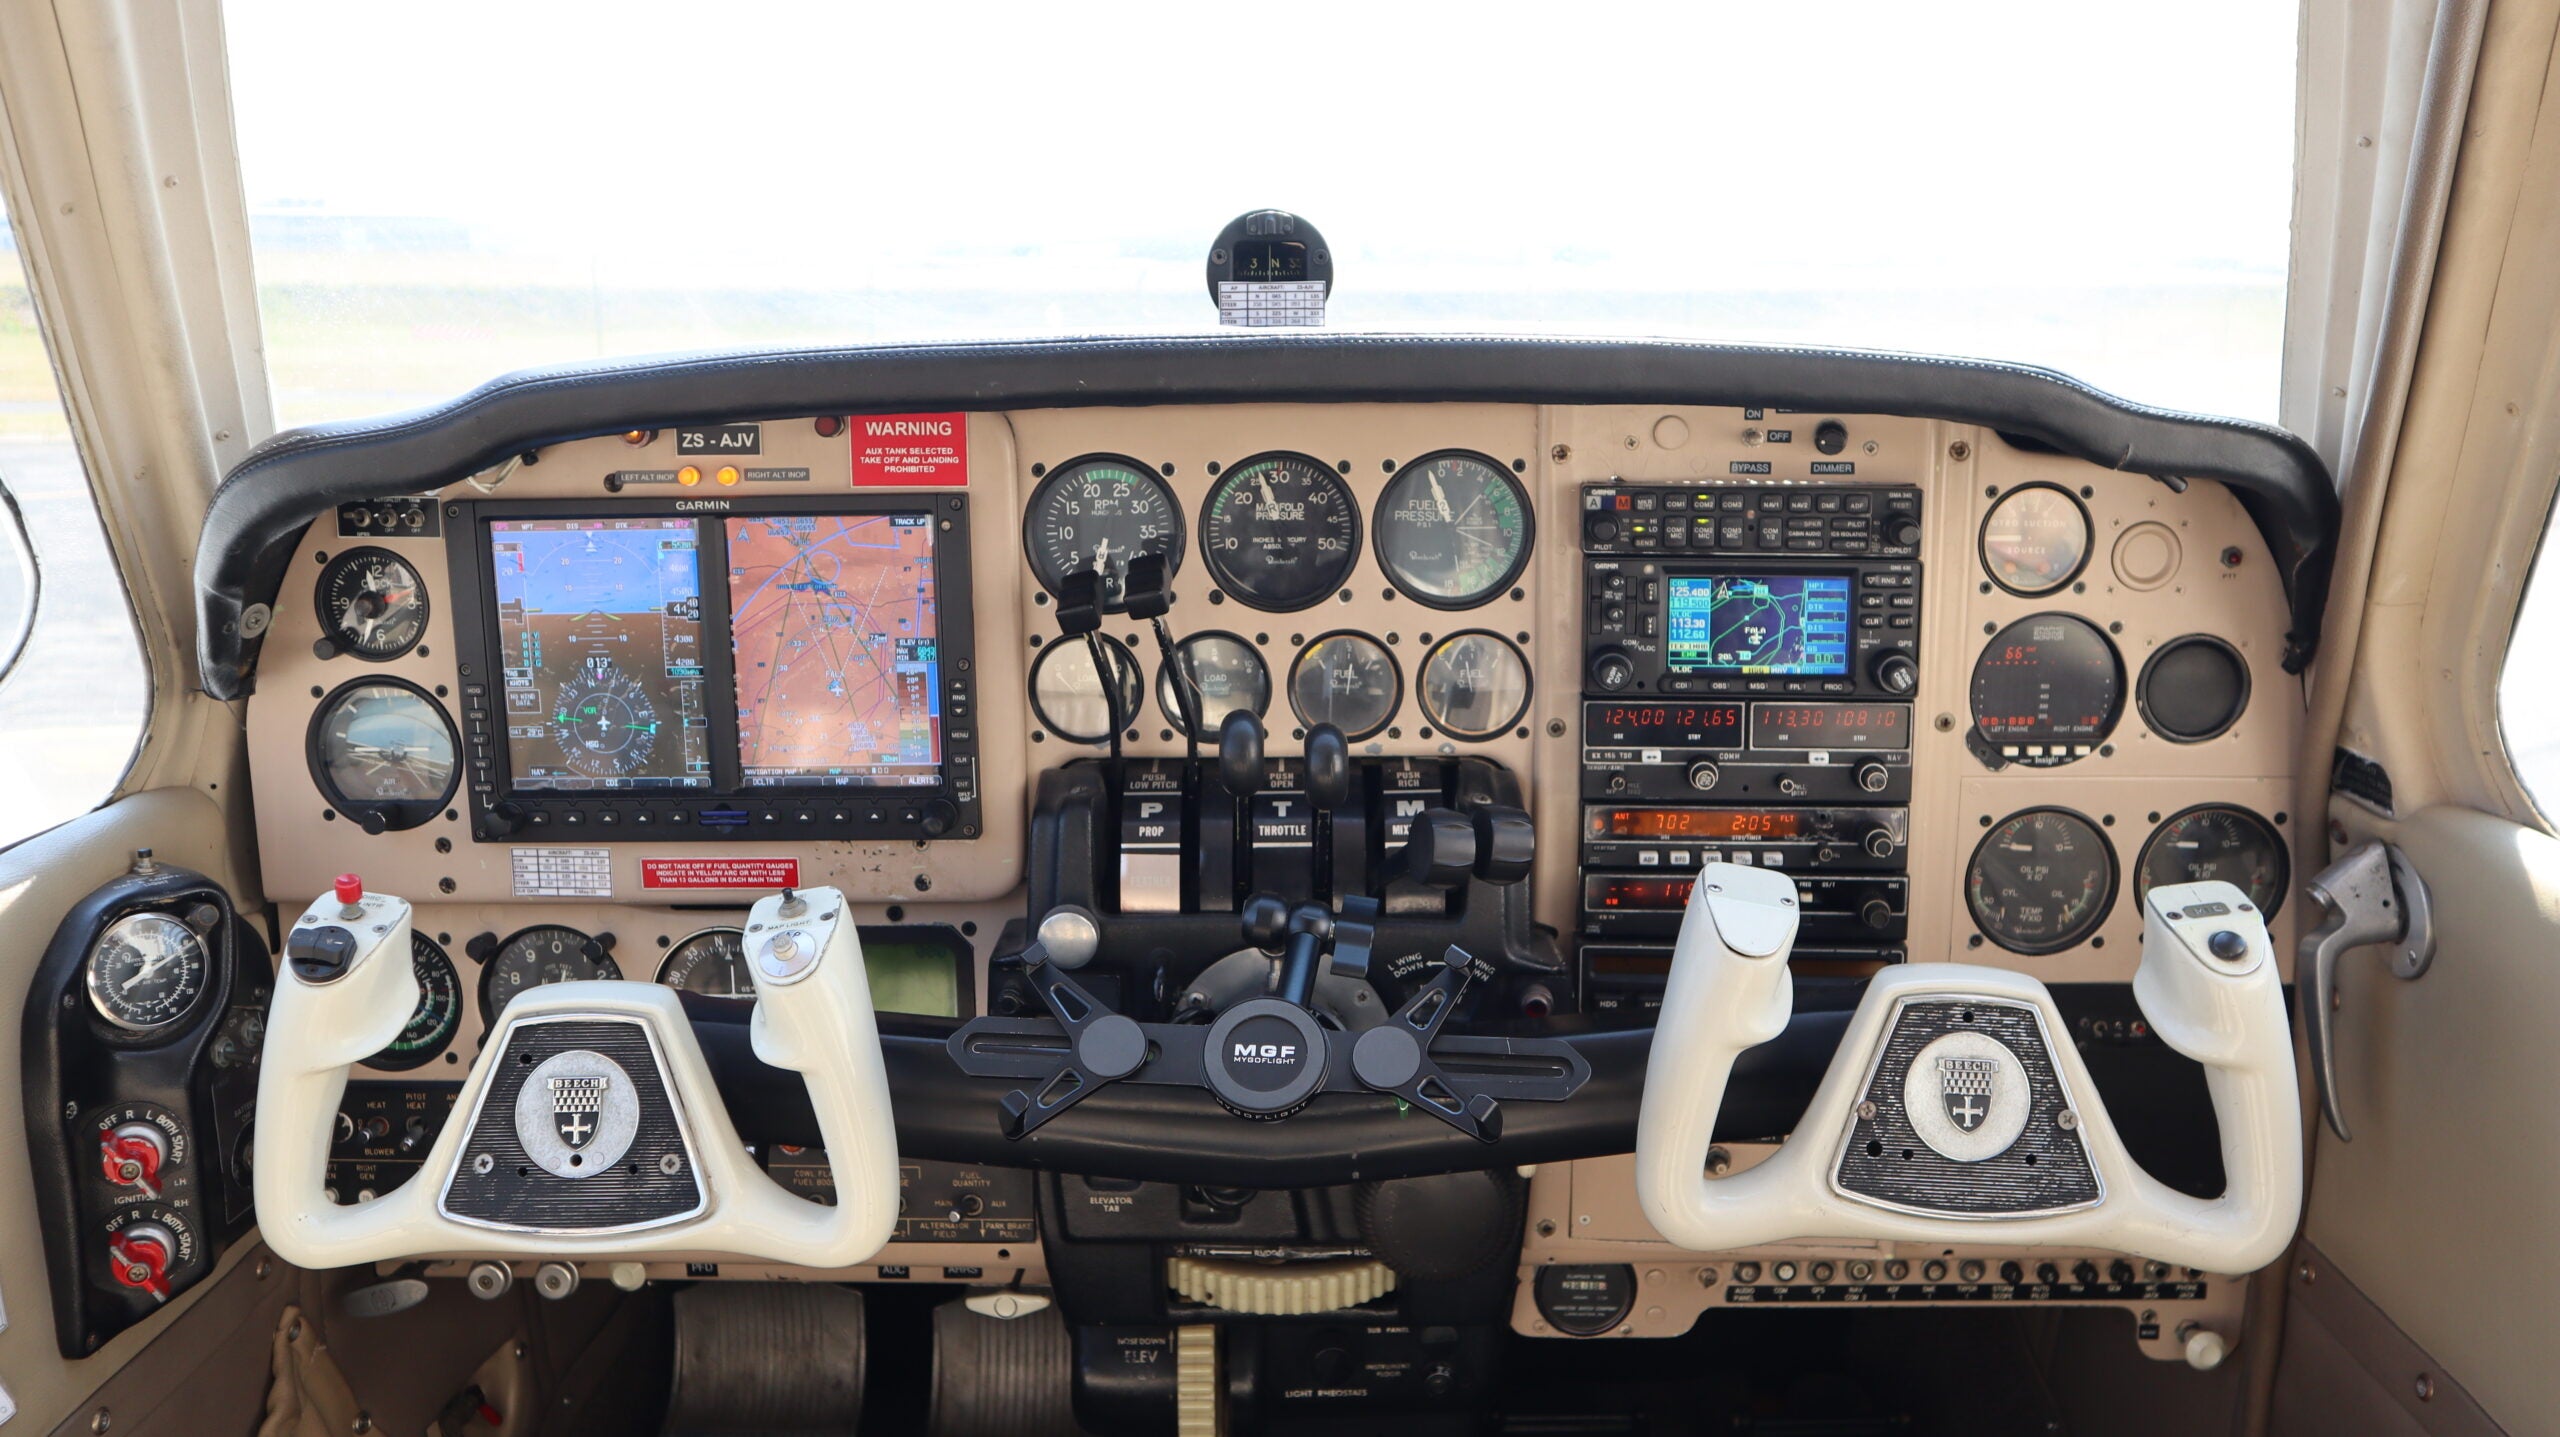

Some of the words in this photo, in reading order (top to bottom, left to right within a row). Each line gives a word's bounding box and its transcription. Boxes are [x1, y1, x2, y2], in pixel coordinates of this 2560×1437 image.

[1746, 410, 1761, 418] ON
[865, 421, 952, 436] WARNING
[682, 433, 705, 448] ZS
[719, 433, 754, 448] AJV
[1769, 432, 1789, 441] OFF
[865, 447, 883, 455] AUX
[884, 447, 907, 455] TANK
[909, 447, 953, 455] SELECTED
[860, 456, 881, 464] TAKE
[883, 456, 900, 464] OFF
[902, 456, 920, 464] AND
[922, 456, 959, 464] LANDING
[884, 465, 935, 473] PROHIBITED
[1731, 463, 1769, 472] BYPASS
[1813, 464, 1851, 472] DIMMER
[620, 473, 639, 481] LEFT
[640, 473, 656, 481] ALT
[656, 473, 675, 481] INOP
[747, 471, 771, 479] RIGHT
[772, 471, 787, 479] ALT
[788, 471, 806, 479] INOP
[1269, 471, 1290, 484] 30
[1301, 478, 1312, 486] 35
[1083, 483, 1101, 498] 20
[1113, 483, 1130, 497] 25
[1234, 492, 1253, 505] 20
[1308, 492, 1328, 504] 40
[1590, 498, 1596, 507] A
[675, 500, 730, 511] GARMIN
[1066, 501, 1080, 516] 15
[1131, 500, 1149, 514] 30
[1255, 502, 1305, 511] MAFOLD
[1409, 499, 1439, 511] FUEL
[894, 518, 915, 526] TRACK
[916, 518, 925, 526] UP
[1059, 526, 1074, 540] 10
[1139, 525, 1157, 539] 35
[1225, 537, 1238, 550] 10
[1318, 537, 1337, 550] 50
[1070, 551, 1079, 565] 5
[371, 565, 383, 577] 12
[1670, 586, 1710, 597] 125.400
[340, 597, 349, 610] 9
[1671, 618, 1706, 629] 113.30
[377, 629, 385, 640] 6
[1672, 629, 1705, 639] 112.60
[1204, 674, 1227, 682] LOAD
[1333, 669, 1358, 679] FUEL
[1604, 708, 1665, 727] 124.00
[1676, 708, 1735, 727] 121.65
[1763, 709, 1824, 727] 113.30
[1887, 754, 1901, 762] NAV
[2035, 755, 2059, 765] Insight
[744, 768, 783, 776] NAVIGATION
[1142, 773, 1166, 782] PUSH
[1269, 772, 1294, 781] PUSH
[1396, 771, 1421, 780] PUSH
[908, 777, 934, 785] ALERTS
[1130, 780, 1151, 790] LOW
[1152, 780, 1177, 790] PITCH
[1270, 779, 1294, 788] OPEN
[1398, 778, 1420, 788] RICH
[1140, 802, 1163, 819] P
[1272, 801, 1292, 818] T
[1396, 800, 1425, 817] M
[1656, 814, 1690, 830] 702
[1732, 814, 1771, 831] 2:05
[1780, 814, 1794, 823] FLT
[1139, 825, 1165, 837] PROP
[1258, 825, 1307, 837] THROTTLE
[714, 935, 723, 948] N
[552, 941, 562, 954] 0
[684, 946, 698, 960] 33
[526, 949, 535, 963] 9
[1395, 952, 1422, 966] WING
[1393, 961, 1424, 979] DOWN
[510, 971, 520, 985] 8
[669, 970, 681, 985] 30
[1234, 1043, 1295, 1058] MGF
[1233, 1056, 1295, 1065] MYGOFLIGHT
[1945, 1060, 1992, 1071] BEECH
[555, 1079, 599, 1089] BEECH
[126, 1109, 134, 1119] R
[1216, 1097, 1307, 1120] MYGOFLIGHT
[145, 1109, 153, 1120] L
[98, 1113, 118, 1130] OFF
[156, 1114, 179, 1136] BOTH
[170, 1135, 183, 1165] START
[365, 1148, 395, 1156] BLOWER
[174, 1199, 189, 1208] RH
[1103, 1205, 1120, 1213] TAB
[131, 1210, 140, 1219] R
[152, 1209, 159, 1220] L
[105, 1215, 124, 1232] OFF
[161, 1212, 185, 1234] BOTH
[920, 1222, 969, 1230] ALTERNATOR
[986, 1222, 1005, 1230] PARK
[1007, 1222, 1032, 1230] BRAKE
[933, 1230, 957, 1238] FIELD
[999, 1230, 1018, 1239] PULL
[178, 1232, 190, 1261] START
[1285, 1390, 1312, 1398] LIGHT
[1318, 1389, 1367, 1397] RHEOSTATS
